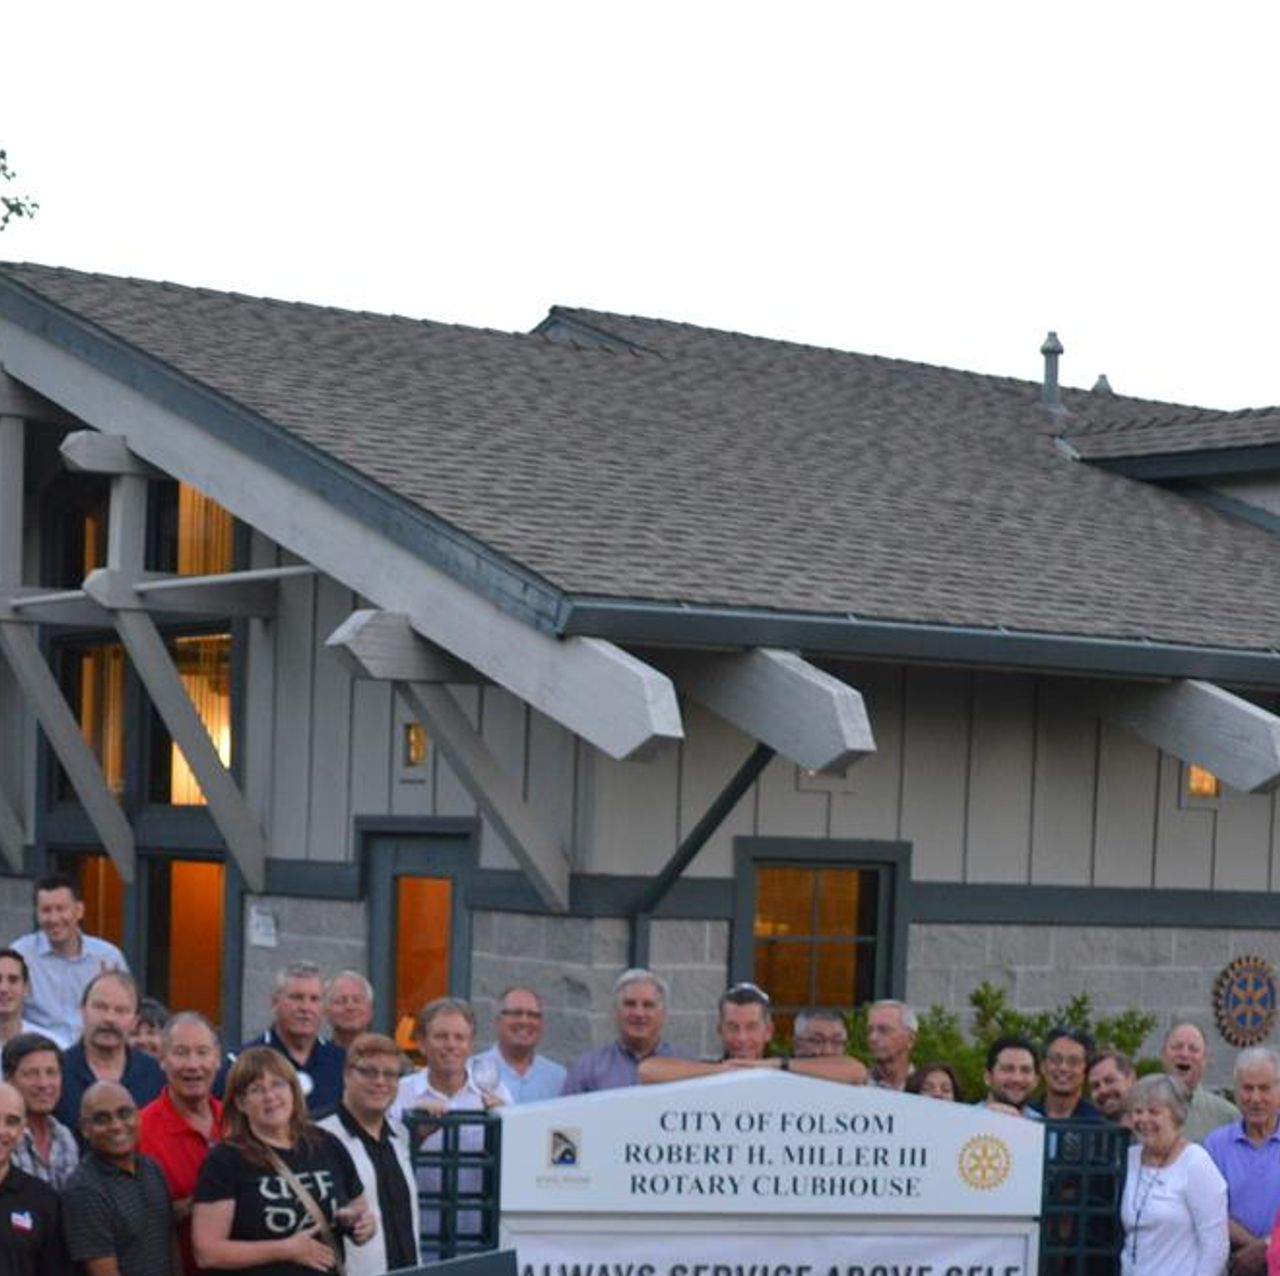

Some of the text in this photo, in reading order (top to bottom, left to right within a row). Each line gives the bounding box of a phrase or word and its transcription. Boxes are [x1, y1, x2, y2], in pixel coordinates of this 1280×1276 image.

[659, 1111, 894, 1134] CITY OF FOLSOM
[624, 1143, 927, 1167] ROBERT H. MILLER III
[630, 1174, 921, 1197] ROTARY CLUBHOUSE
